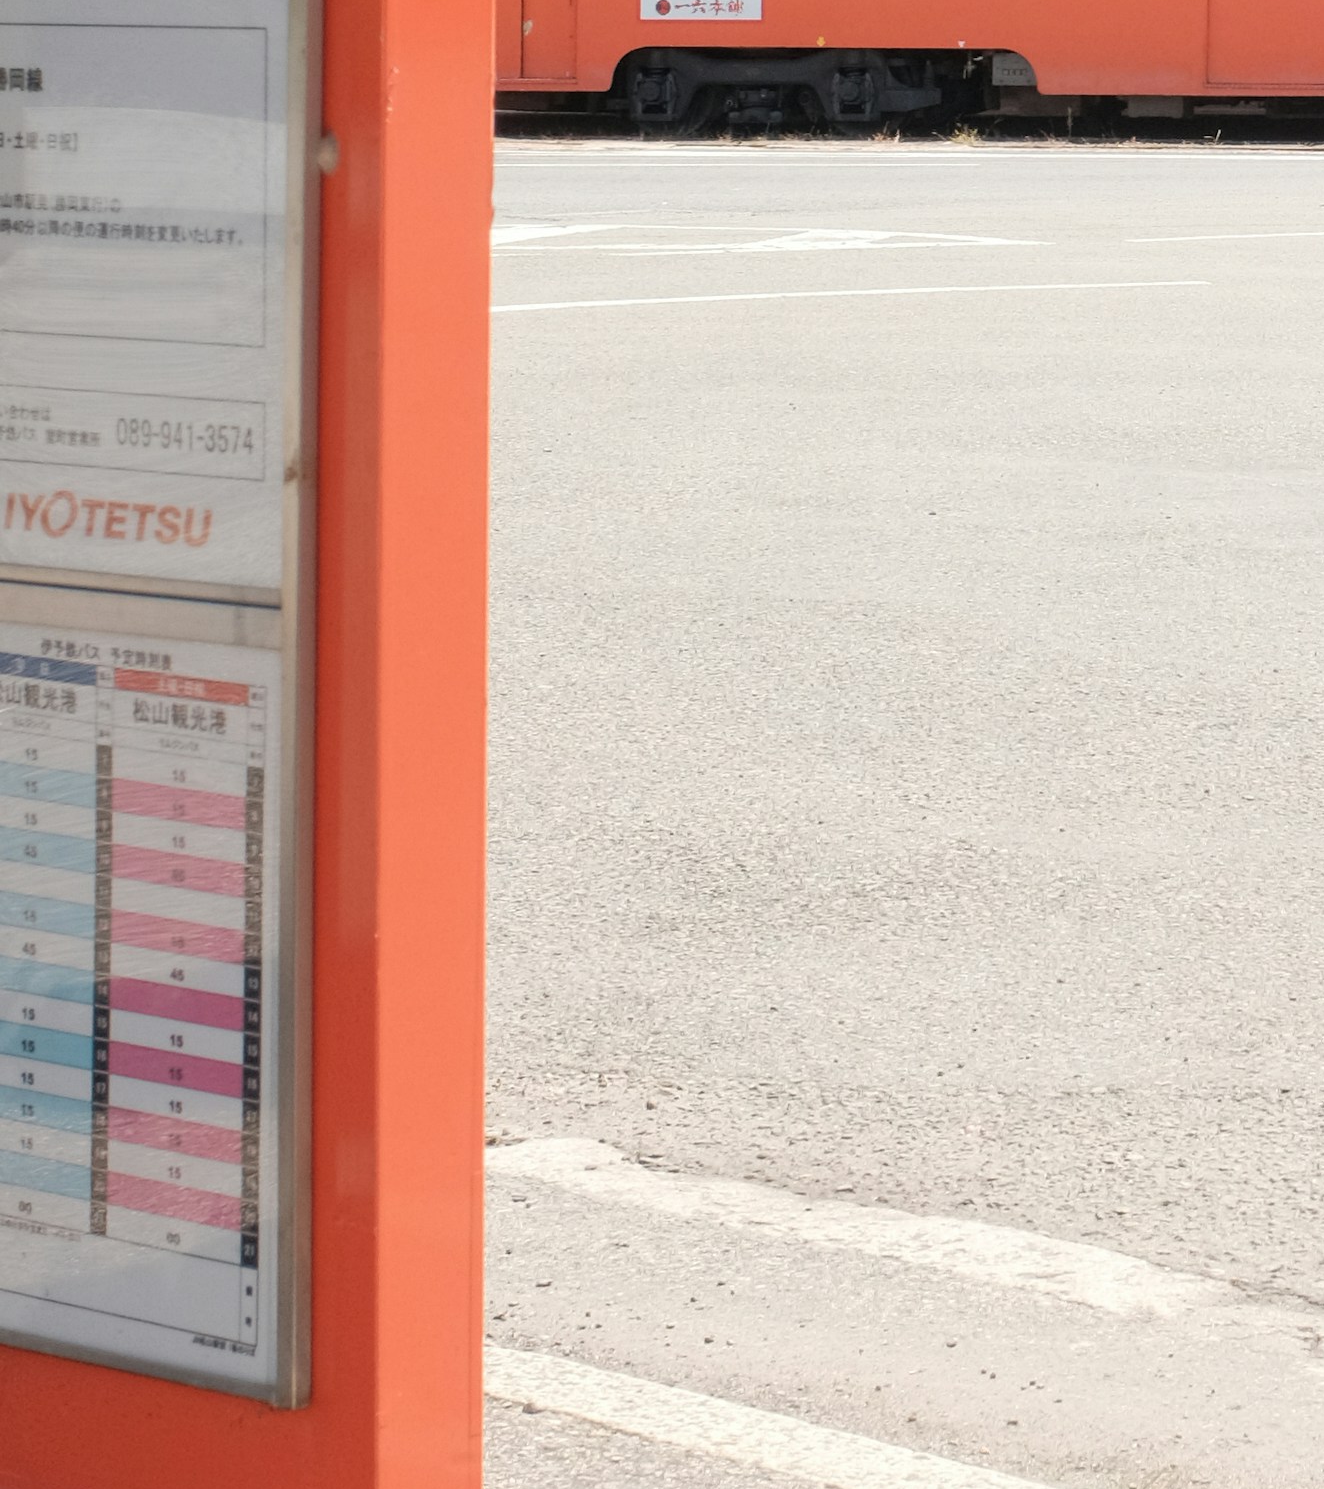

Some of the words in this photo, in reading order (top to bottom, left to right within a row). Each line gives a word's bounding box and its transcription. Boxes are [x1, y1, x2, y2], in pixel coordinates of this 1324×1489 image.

[116, 418, 254, 454] 089-941-3574
[5, 489, 213, 548] IYOTETSU
[133, 697, 226, 735] 松山観光港
